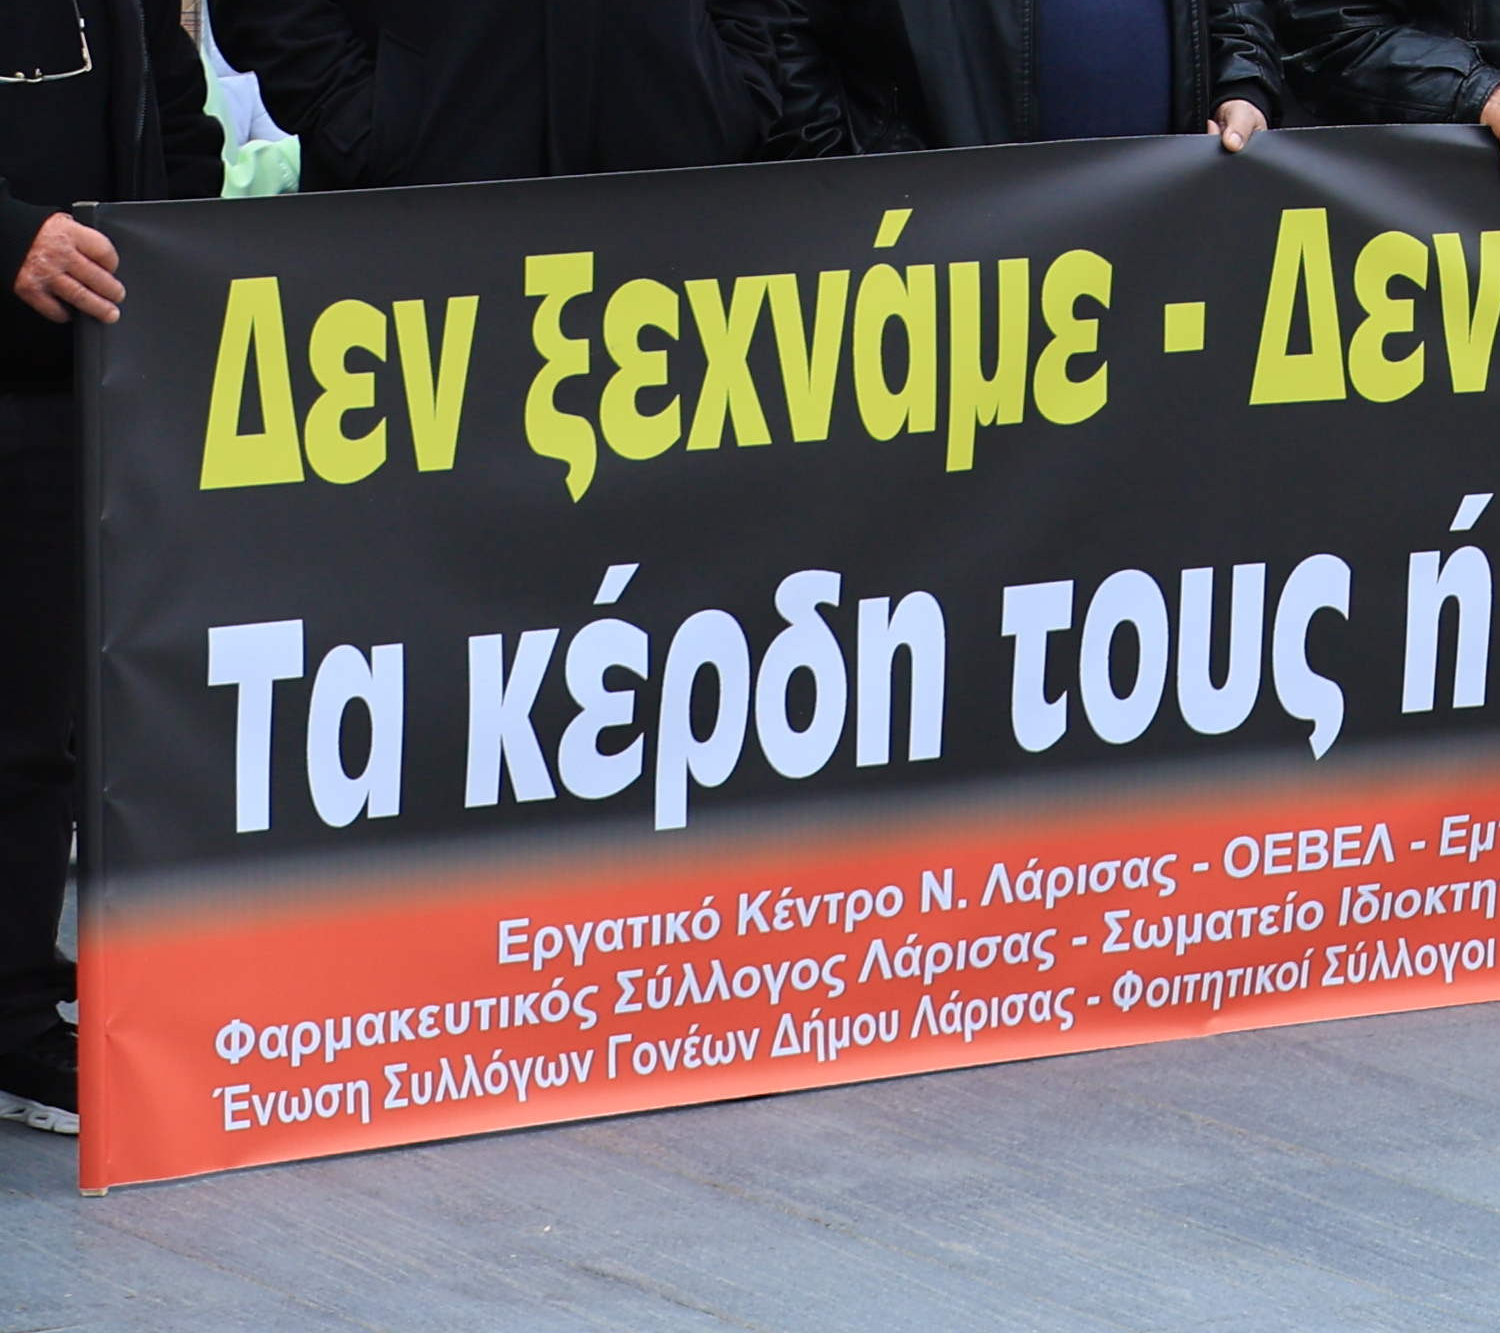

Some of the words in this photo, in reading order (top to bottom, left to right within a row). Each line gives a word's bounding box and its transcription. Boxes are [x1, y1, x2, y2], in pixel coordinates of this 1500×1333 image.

[200, 277, 477, 490] Δεν
[524, 209, 1112, 503] ξεχνάμε
[208, 619, 403, 832] Τα
[465, 563, 945, 830] κέρδη
[1002, 555, 1350, 760] τους
[1403, 492, 1495, 713] ή
[215, 978, 599, 1066] Φαρμακευτικός
[613, 952, 845, 1016] Σύλλογος
[860, 925, 1056, 988] Λάρισας
[1102, 885, 1330, 957] Σωματείο
[498, 892, 719, 967] Εργατικό
[736, 880, 904, 937] Κέντρο
[920, 868, 967, 913] Ν.
[981, 849, 1178, 908] Λάρισας
[1222, 825, 1393, 878] ΟΕΒΕΛ
[213, 1081, 370, 1132] Ένωση
[382, 1051, 595, 1113] Συλλόγων
[607, 1026, 759, 1081] Γονέων
[770, 1006, 900, 1064] Δήμου
[911, 985, 1075, 1041] Λάρισας
[1112, 945, 1312, 1021] Φοιτητικοί
[1322, 932, 1497, 993] Σύλλογοι
